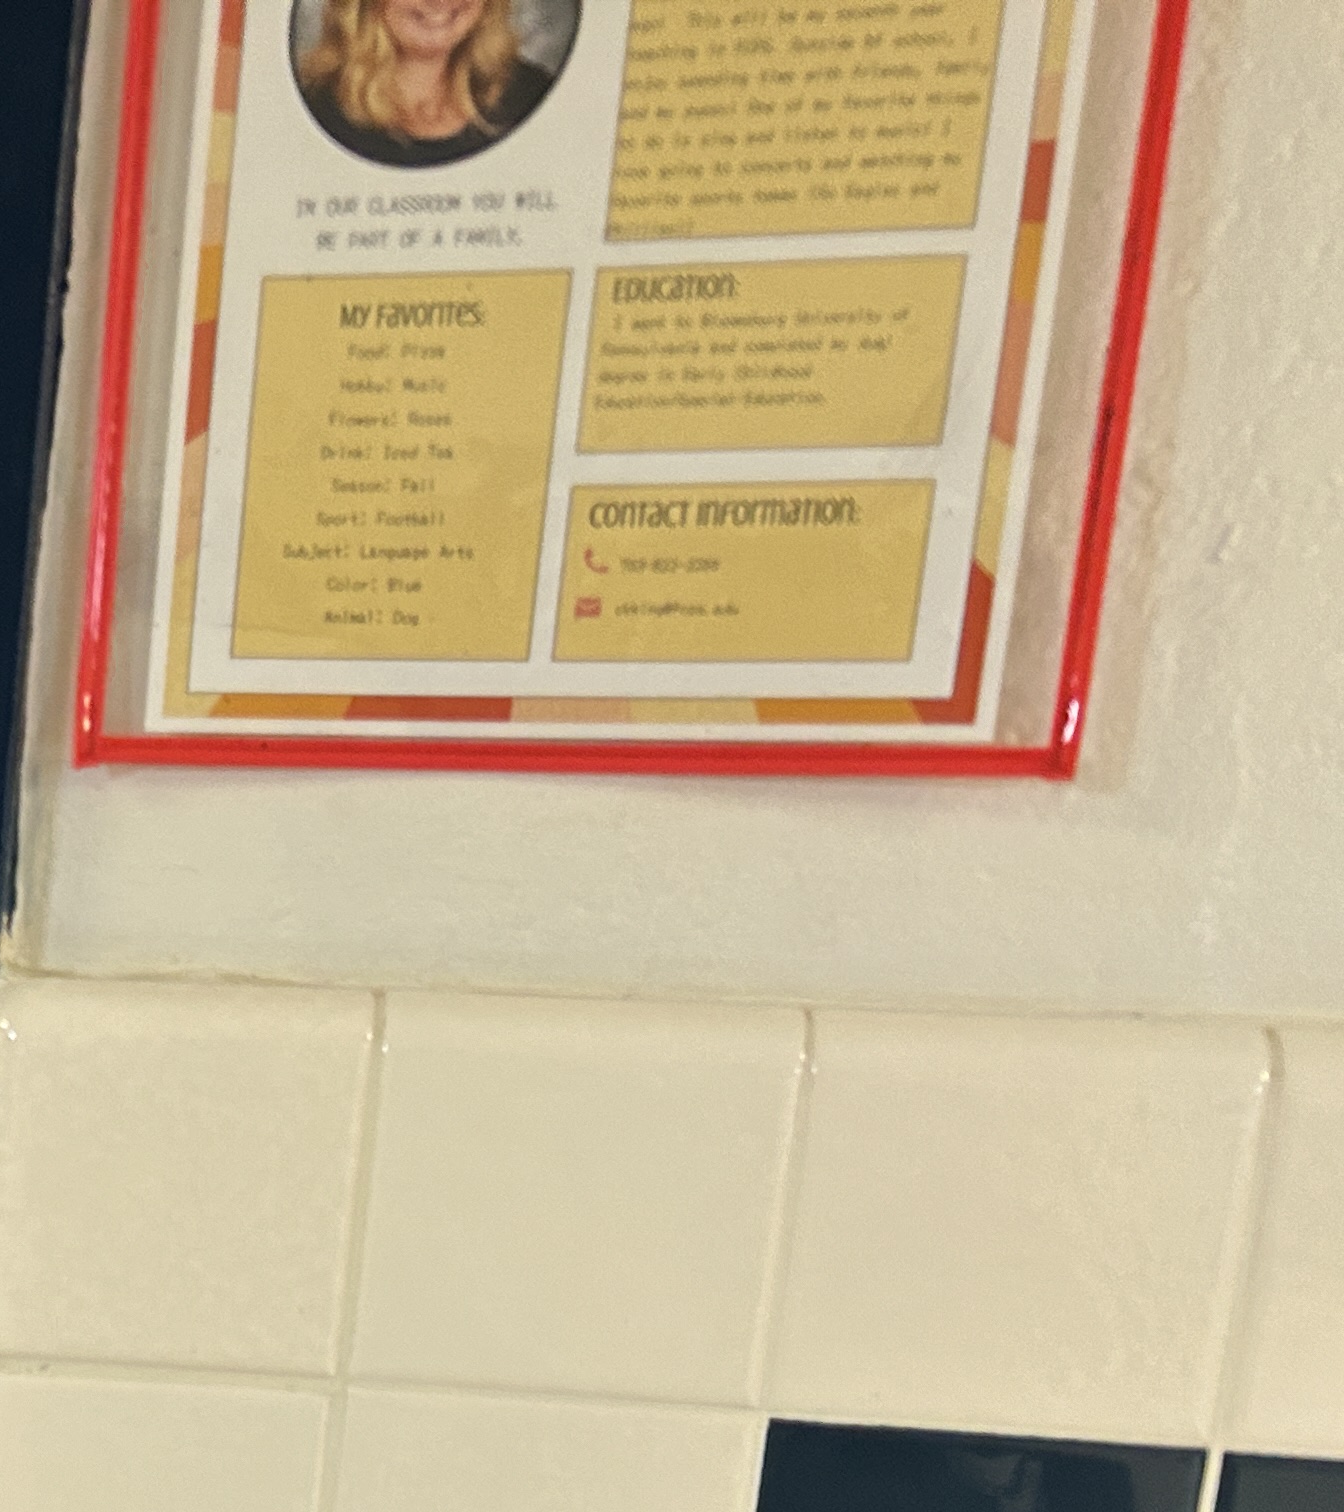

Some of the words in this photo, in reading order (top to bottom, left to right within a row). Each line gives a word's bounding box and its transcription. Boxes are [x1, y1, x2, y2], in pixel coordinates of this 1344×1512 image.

[326, 195, 358, 218] OUR
[366, 193, 461, 217] CLASSROOM
[472, 190, 506, 213] YOU
[515, 188, 558, 212] WILL
[348, 227, 389, 249] PART
